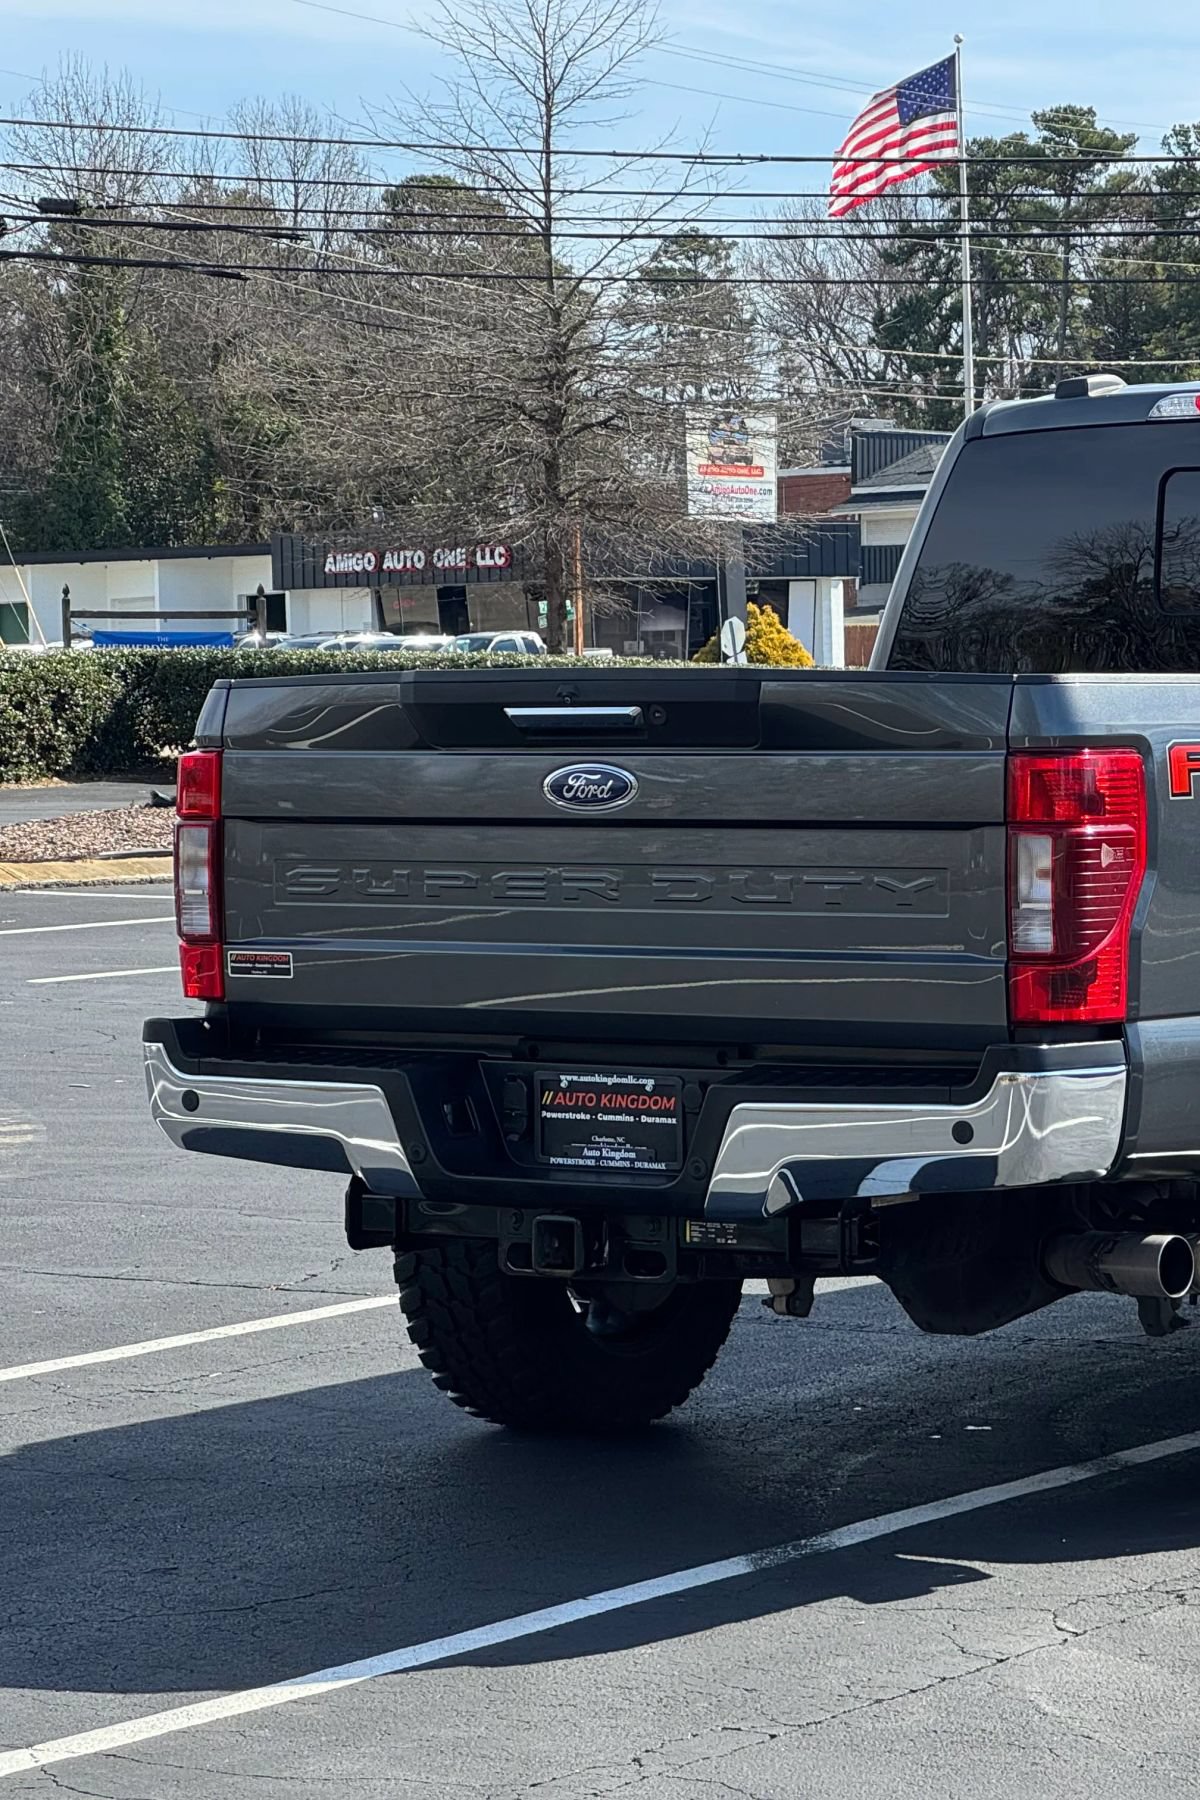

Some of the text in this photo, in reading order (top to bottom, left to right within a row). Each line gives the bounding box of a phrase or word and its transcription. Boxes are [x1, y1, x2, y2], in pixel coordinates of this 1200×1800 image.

[325, 546, 509, 573] AMIGO AUTO ONE LLC
[563, 773, 614, 799] Ford
[285, 867, 938, 906] SUPER DUTY
[559, 1073, 656, 1086] www.autokingdomllc.com
[600, 1093, 676, 1111] KINGDOM
[541, 1110, 591, 1120] Powerstroke
[597, 1112, 634, 1122] Cummins
[641, 1115, 677, 1125] Duramax
[582, 1147, 636, 1160] Auto Kingdom
